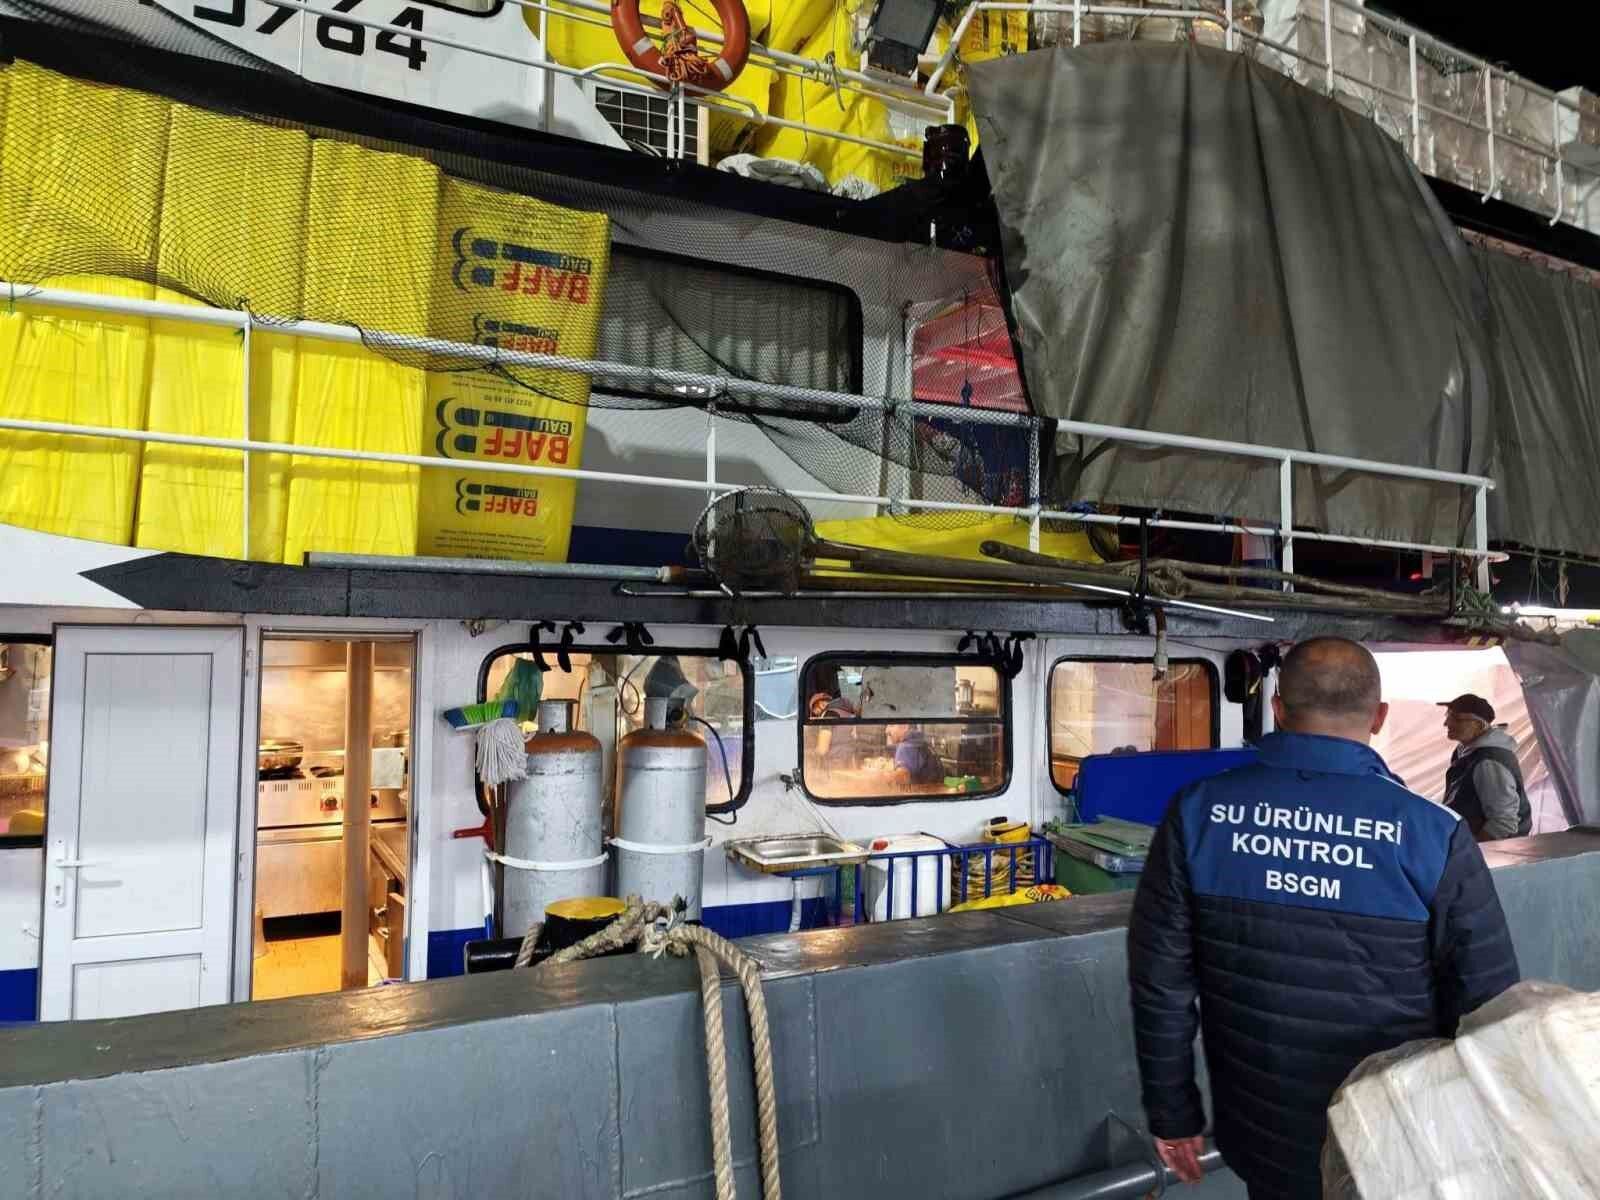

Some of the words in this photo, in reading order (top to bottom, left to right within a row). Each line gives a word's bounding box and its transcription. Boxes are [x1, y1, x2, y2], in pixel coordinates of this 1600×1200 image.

[502, 262, 589, 304] BAFF
[539, 418, 570, 435] BAU
[484, 427, 571, 465] BAFF
[484, 495, 538, 517] BAFF
[1210, 803, 1245, 825] SU
[1253, 802, 1402, 846] ÜRÜNLERİ
[1232, 832, 1374, 870] KONTROL
[1266, 870, 1341, 900] BSGM
